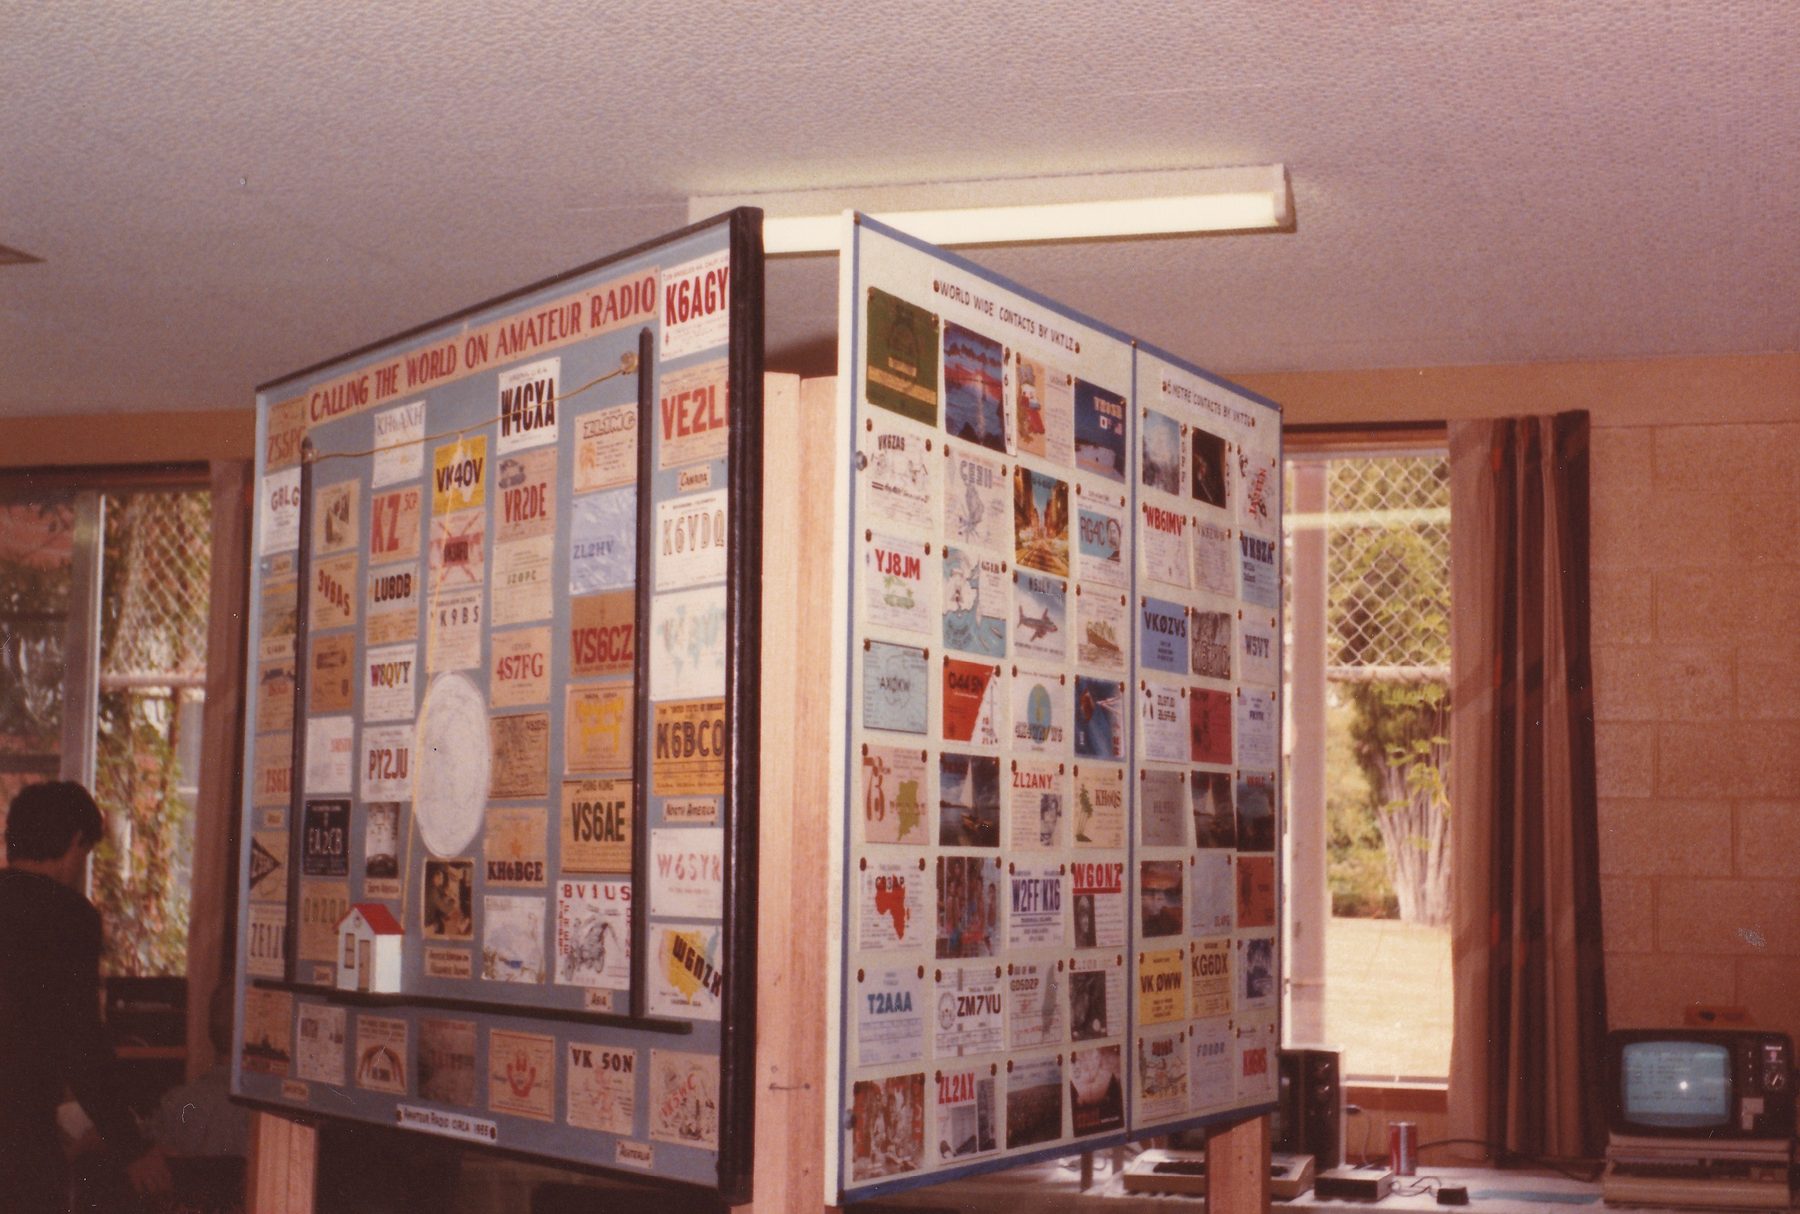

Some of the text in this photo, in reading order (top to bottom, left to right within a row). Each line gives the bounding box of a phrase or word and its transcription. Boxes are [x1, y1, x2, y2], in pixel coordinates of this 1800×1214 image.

[665, 267, 729, 327] K6AGY
[939, 281, 970, 305] WORLD
[973, 295, 994, 317] WIDE
[999, 307, 1036, 335] CONTACTS
[1038, 325, 1048, 340] BY
[310, 276, 656, 422] CALLING THE WORLD ON AMATEUR RADIO
[501, 378, 555, 438] W4CXA
[1193, 392, 1221, 416] CONTACTS
[504, 482, 547, 524] VR2DE
[875, 549, 921, 581] YJ8JM
[572, 624, 634, 665] VS6CZ
[656, 719, 725, 760] K6BCO
[571, 801, 626, 842] VS6AE
[1192, 953, 1229, 978] KG6DX
[956, 987, 1001, 1018] ZM7VU
